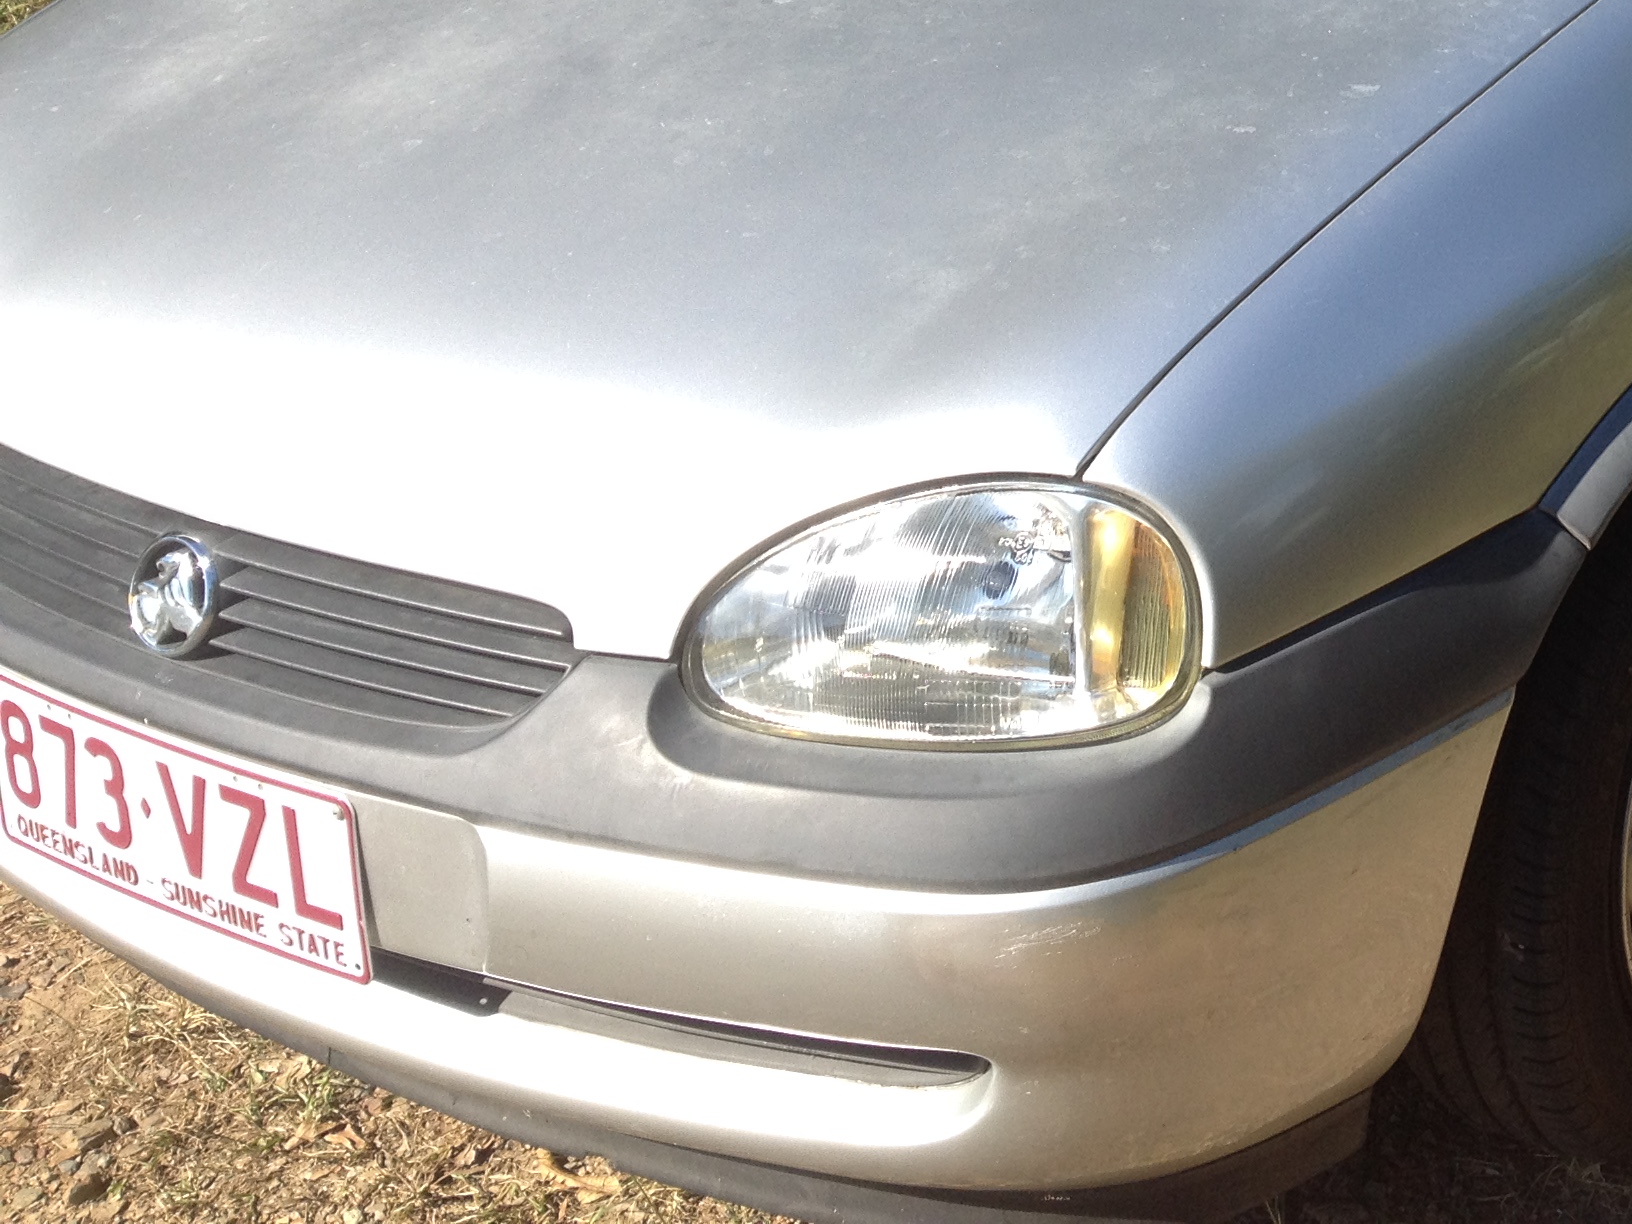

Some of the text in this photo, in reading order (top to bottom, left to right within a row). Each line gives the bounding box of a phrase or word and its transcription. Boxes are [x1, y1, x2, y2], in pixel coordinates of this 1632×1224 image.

[17, 813, 139, 886] QUEENSLAND
[161, 877, 268, 939] SUNSHINE
[278, 922, 348, 968] STATE
